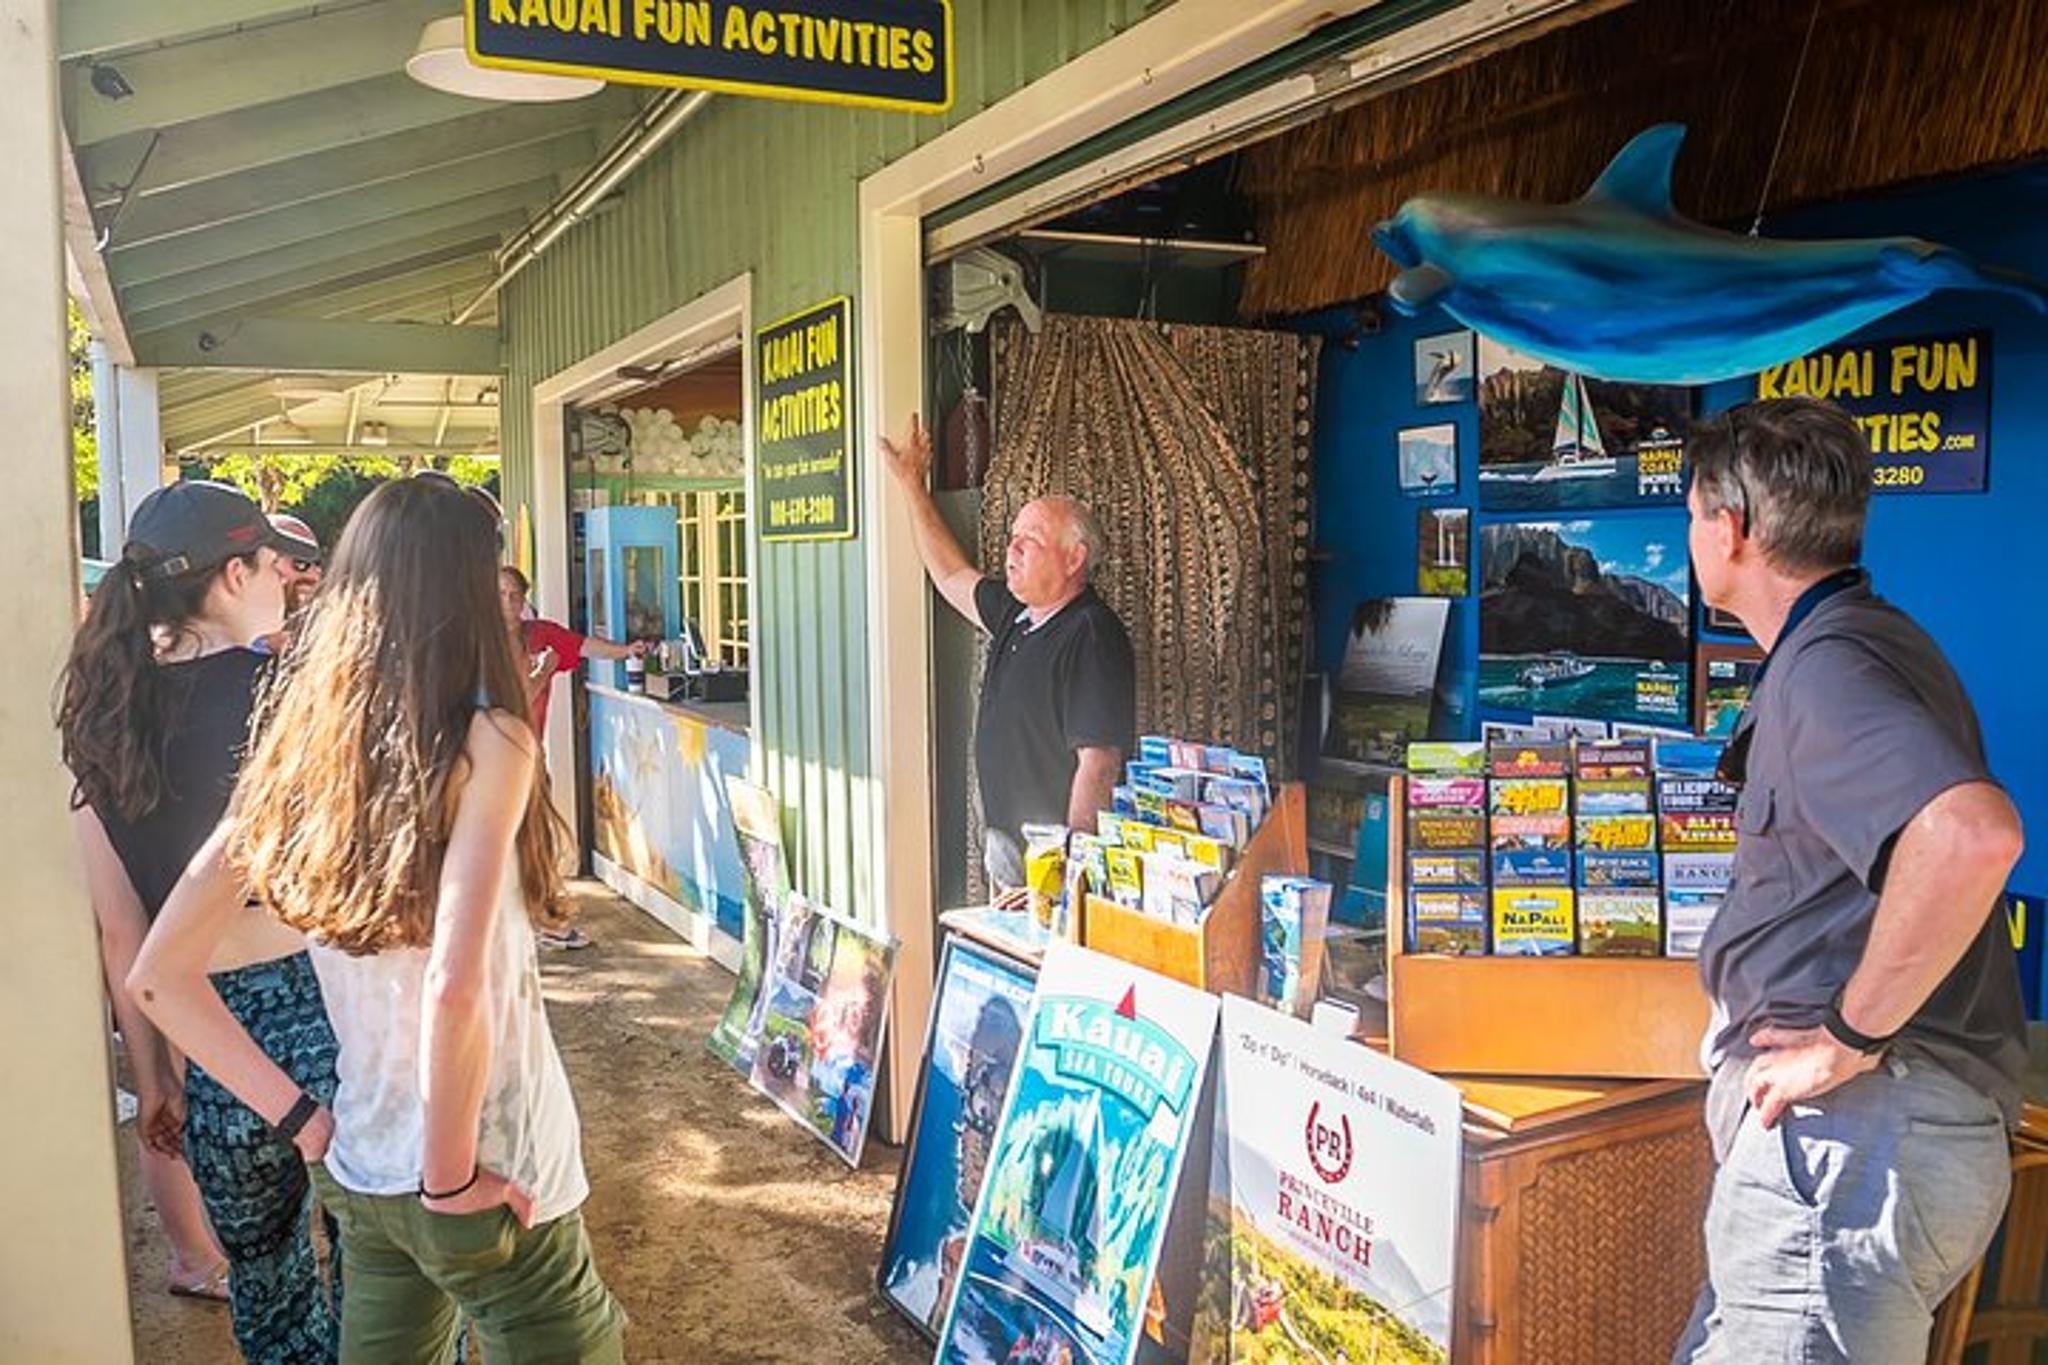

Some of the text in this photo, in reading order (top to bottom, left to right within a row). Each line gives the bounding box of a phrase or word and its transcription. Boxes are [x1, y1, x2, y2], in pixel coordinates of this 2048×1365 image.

[489, 0, 935, 73] KAUAI FUN ACTIVITIES
[762, 314, 838, 384] KAUAI FUN
[1759, 338, 1978, 401] KAUAI FUN
[762, 380, 841, 444] ACTIVITIES
[1051, 1003, 1185, 1098] Kauai
[1064, 1050, 1154, 1108] SEA TOURS
[1316, 1123, 1341, 1161] PR
[1278, 1191, 1372, 1267] RANCH
[1279, 1170, 1374, 1235] PRINCEVILLE
